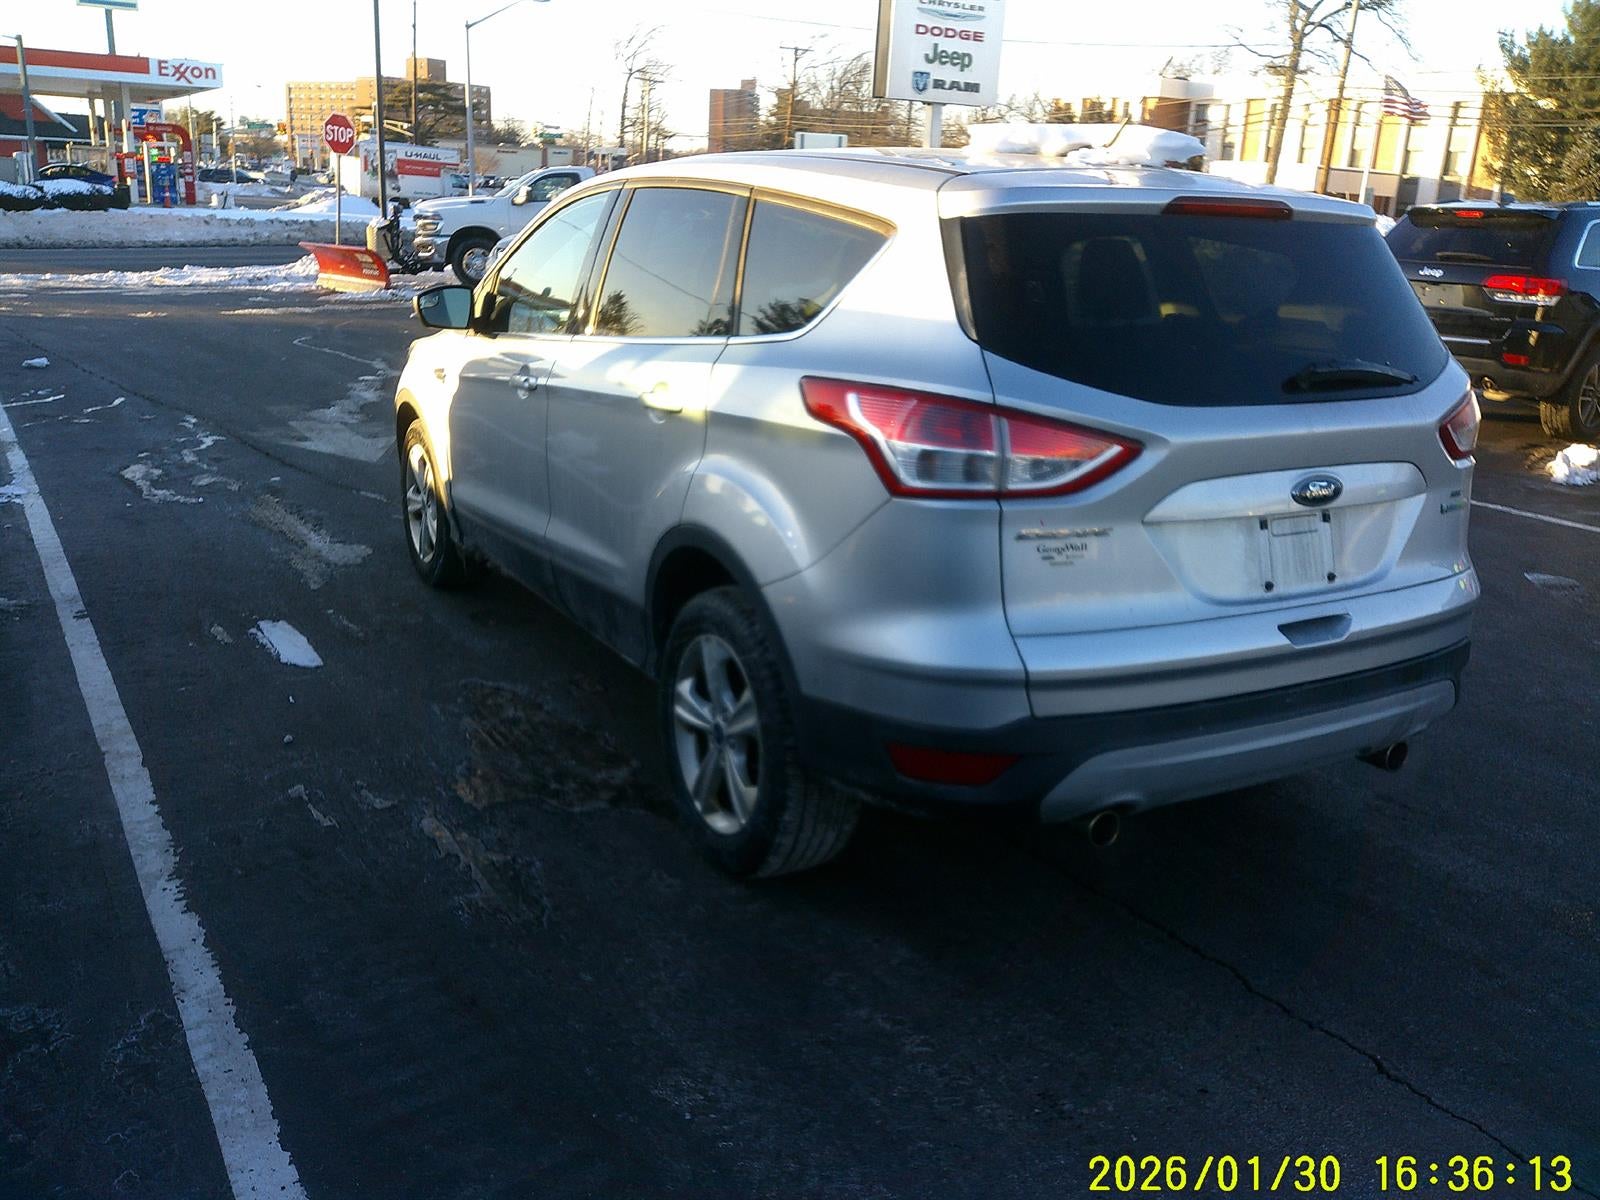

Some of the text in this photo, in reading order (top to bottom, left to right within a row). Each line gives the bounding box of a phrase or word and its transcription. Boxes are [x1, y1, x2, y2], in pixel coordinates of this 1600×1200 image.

[919, 0, 985, 11] CHRYSLER
[915, 24, 985, 42] DODGE
[924, 43, 973, 72] Jeep
[157, 59, 217, 84] Exxon
[932, 78, 981, 93] RAM
[326, 124, 354, 144] STOP
[1418, 266, 1444, 278] Jeep
